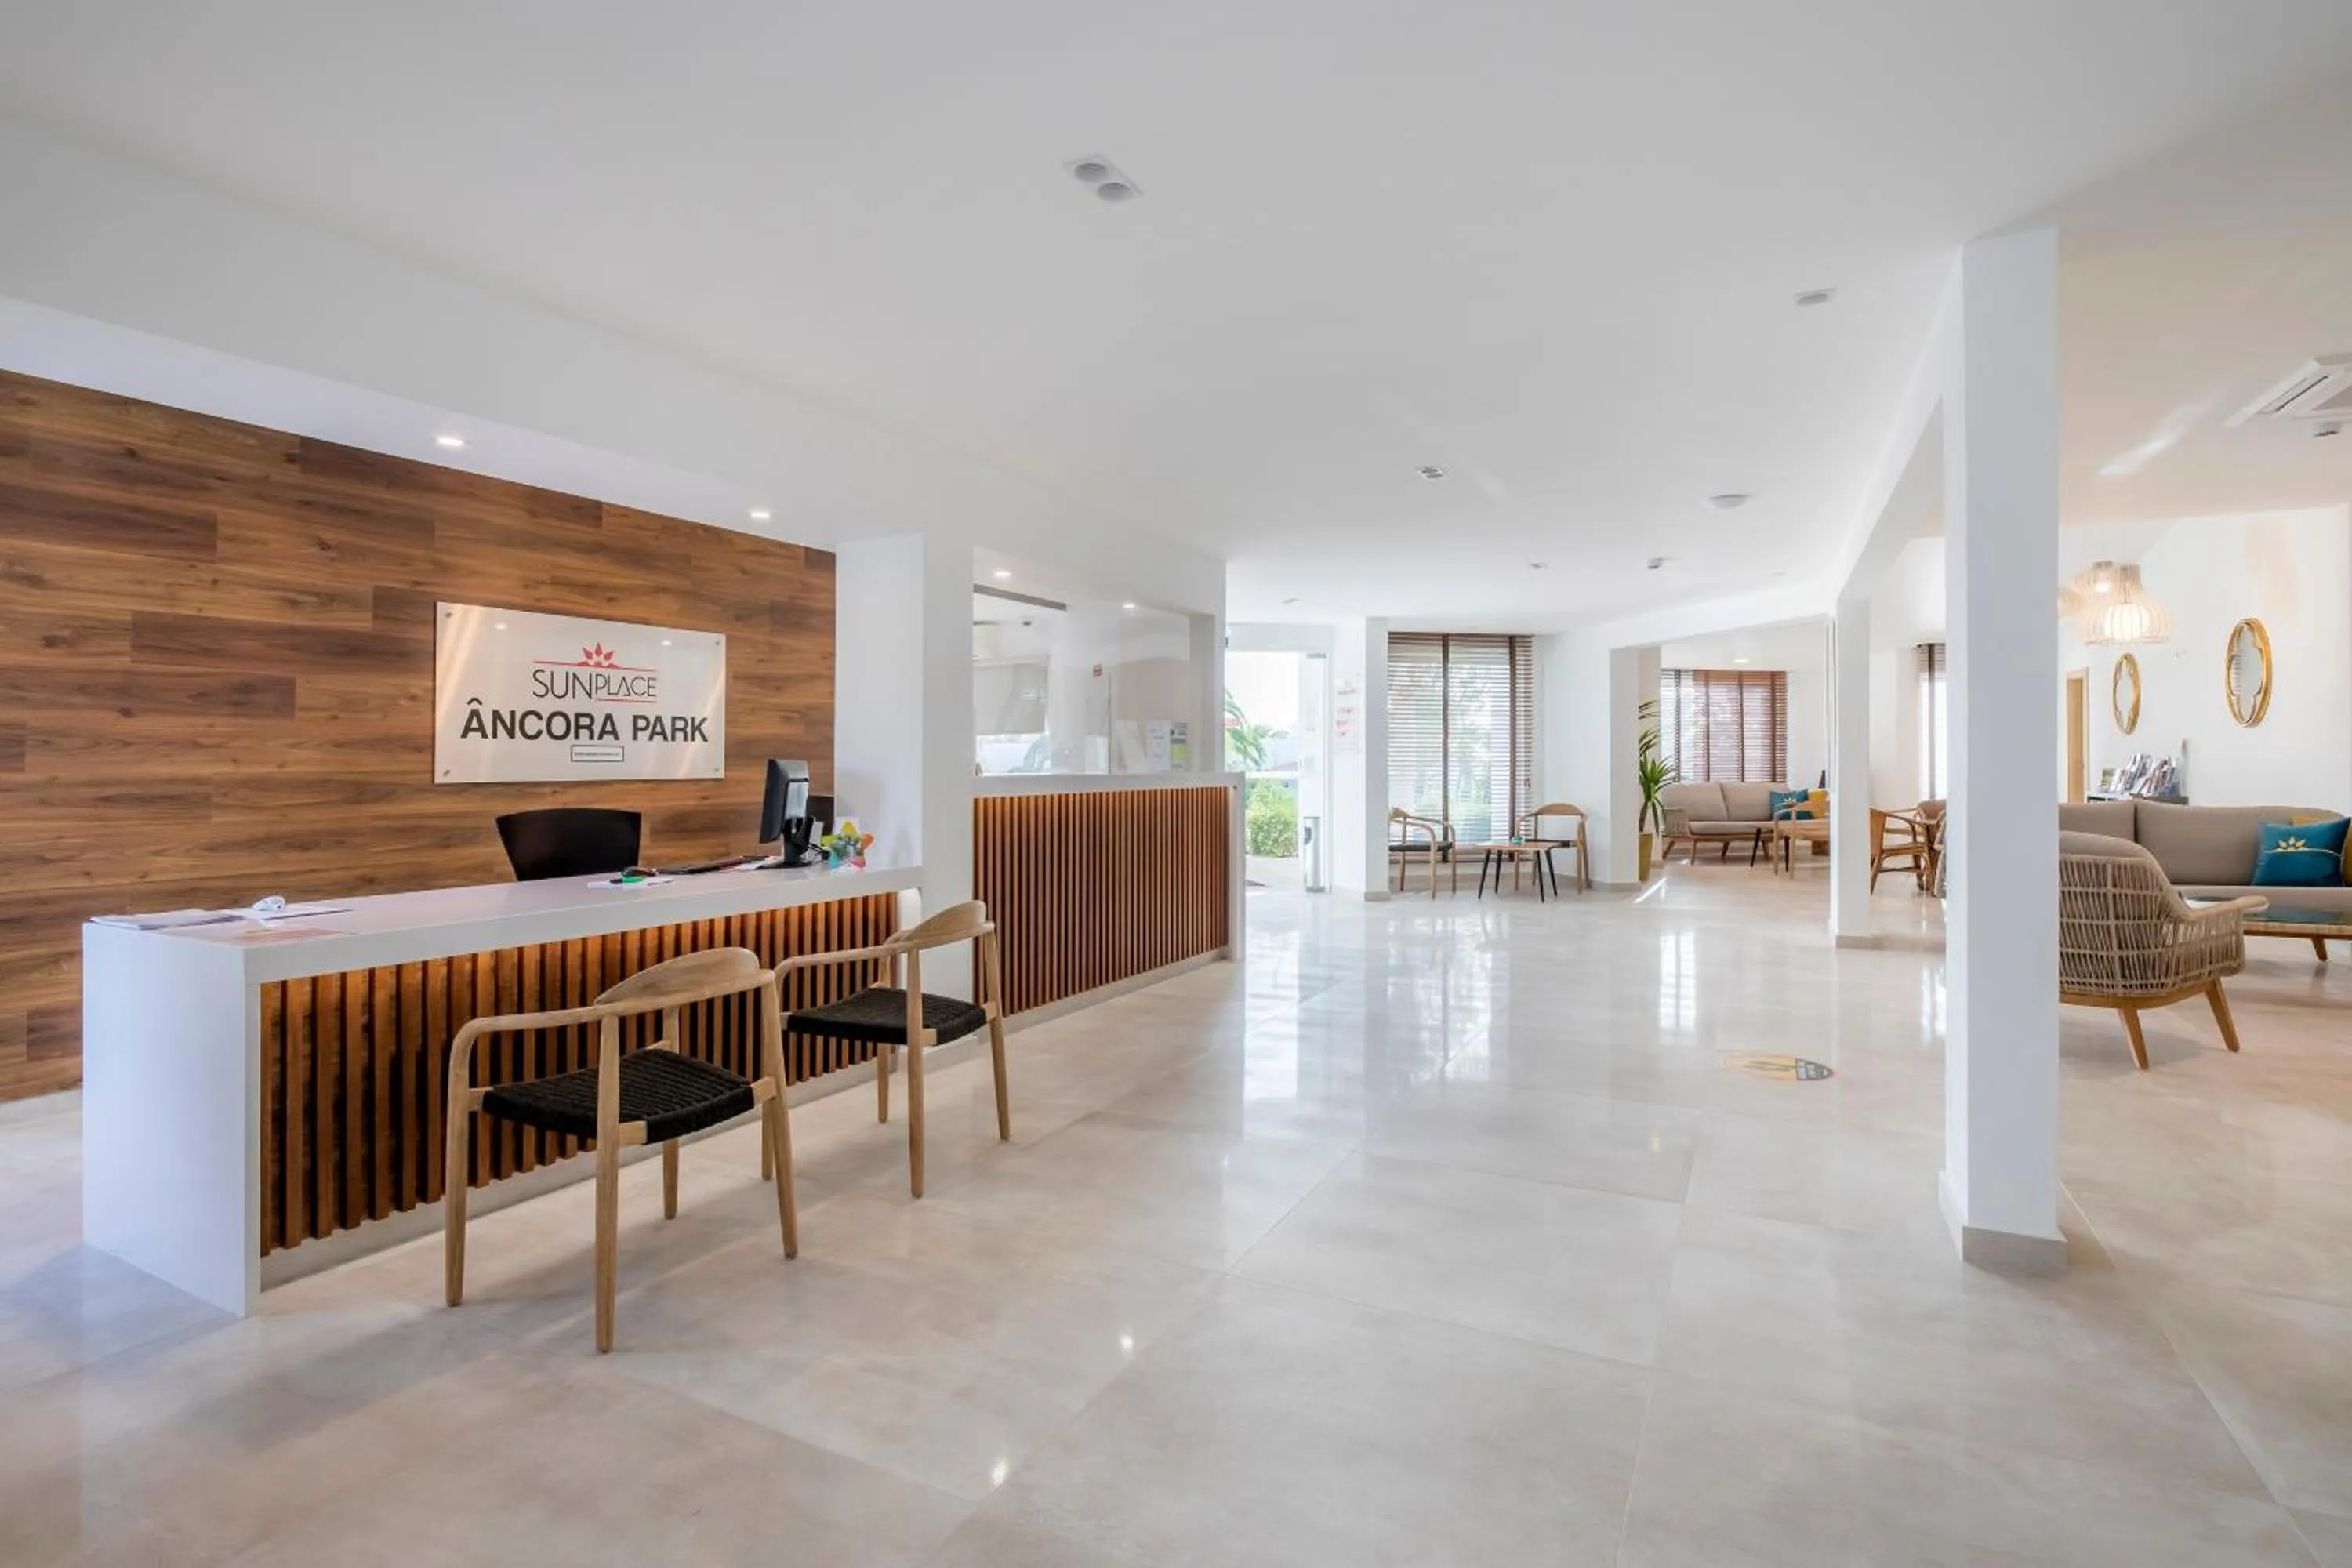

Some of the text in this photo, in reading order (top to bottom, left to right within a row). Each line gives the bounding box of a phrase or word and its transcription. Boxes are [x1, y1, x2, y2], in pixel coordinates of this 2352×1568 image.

[532, 669, 657, 699] SUNPLACE
[460, 697, 709, 742] ÂNCORA PARK
